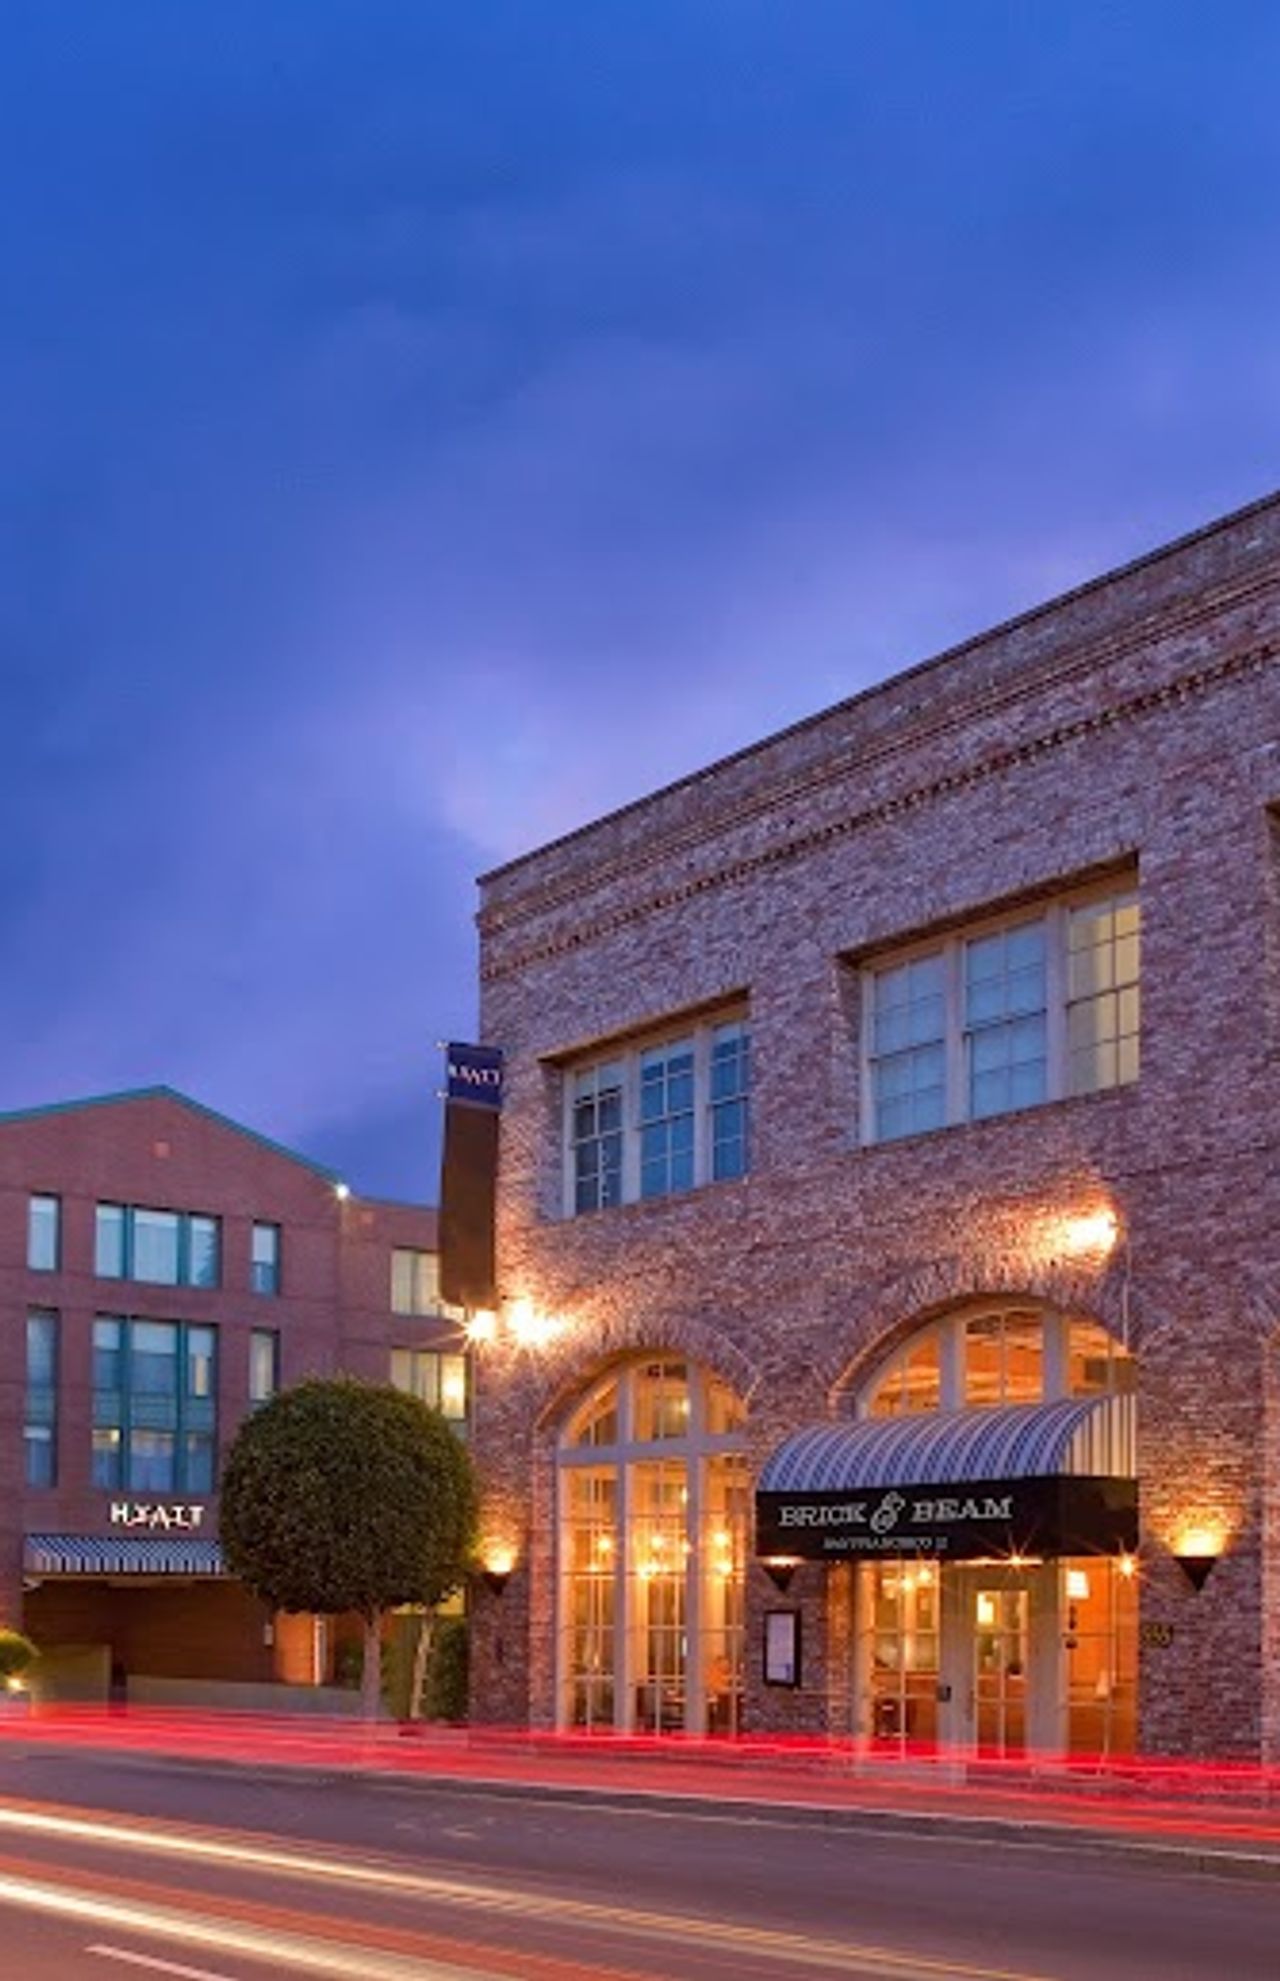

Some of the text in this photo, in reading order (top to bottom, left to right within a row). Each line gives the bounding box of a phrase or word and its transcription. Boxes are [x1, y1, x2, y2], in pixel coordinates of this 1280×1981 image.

[110, 1502, 205, 1530] HYATT
[778, 1502, 868, 1527] BRICK
[910, 1497, 1014, 1524] BEAM
